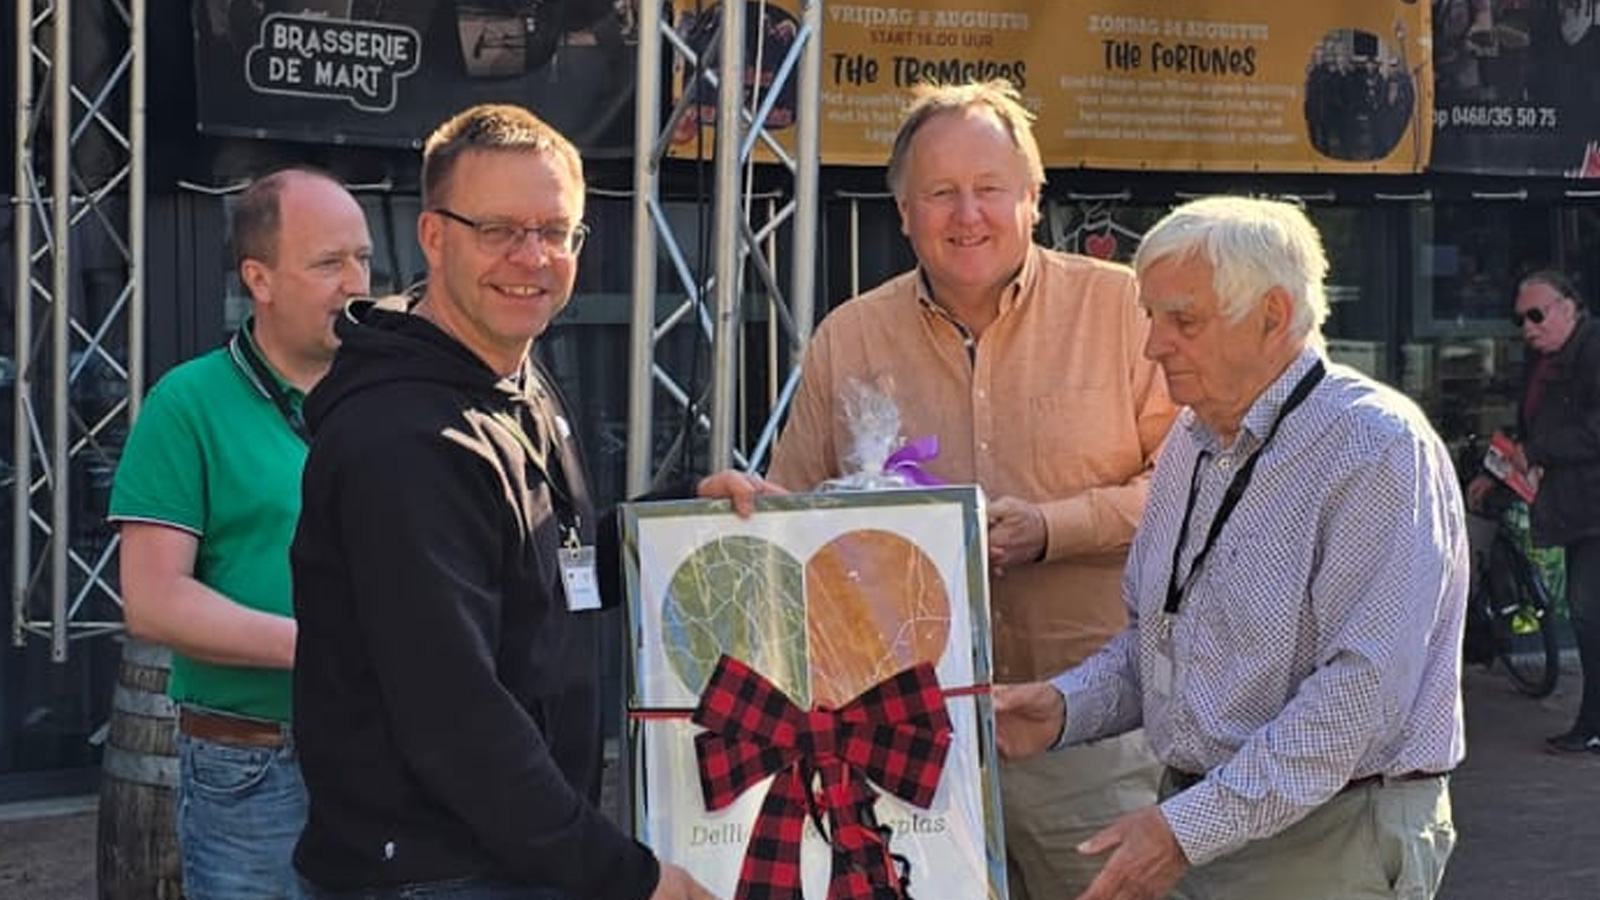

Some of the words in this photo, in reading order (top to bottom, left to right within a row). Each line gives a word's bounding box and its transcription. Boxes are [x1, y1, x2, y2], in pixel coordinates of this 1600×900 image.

[829, 6, 913, 27] VRIJDAG
[1087, 15, 1159, 34] ZONDAG
[273, 24, 409, 65] BRASSERIE
[870, 30, 913, 46] START
[961, 33, 993, 48] UUR
[269, 56, 301, 83] DE
[315, 61, 382, 97] MART
[1517, 107, 1537, 127] 50
[1540, 108, 1556, 127] 75
[690, 823, 748, 845] Delli
